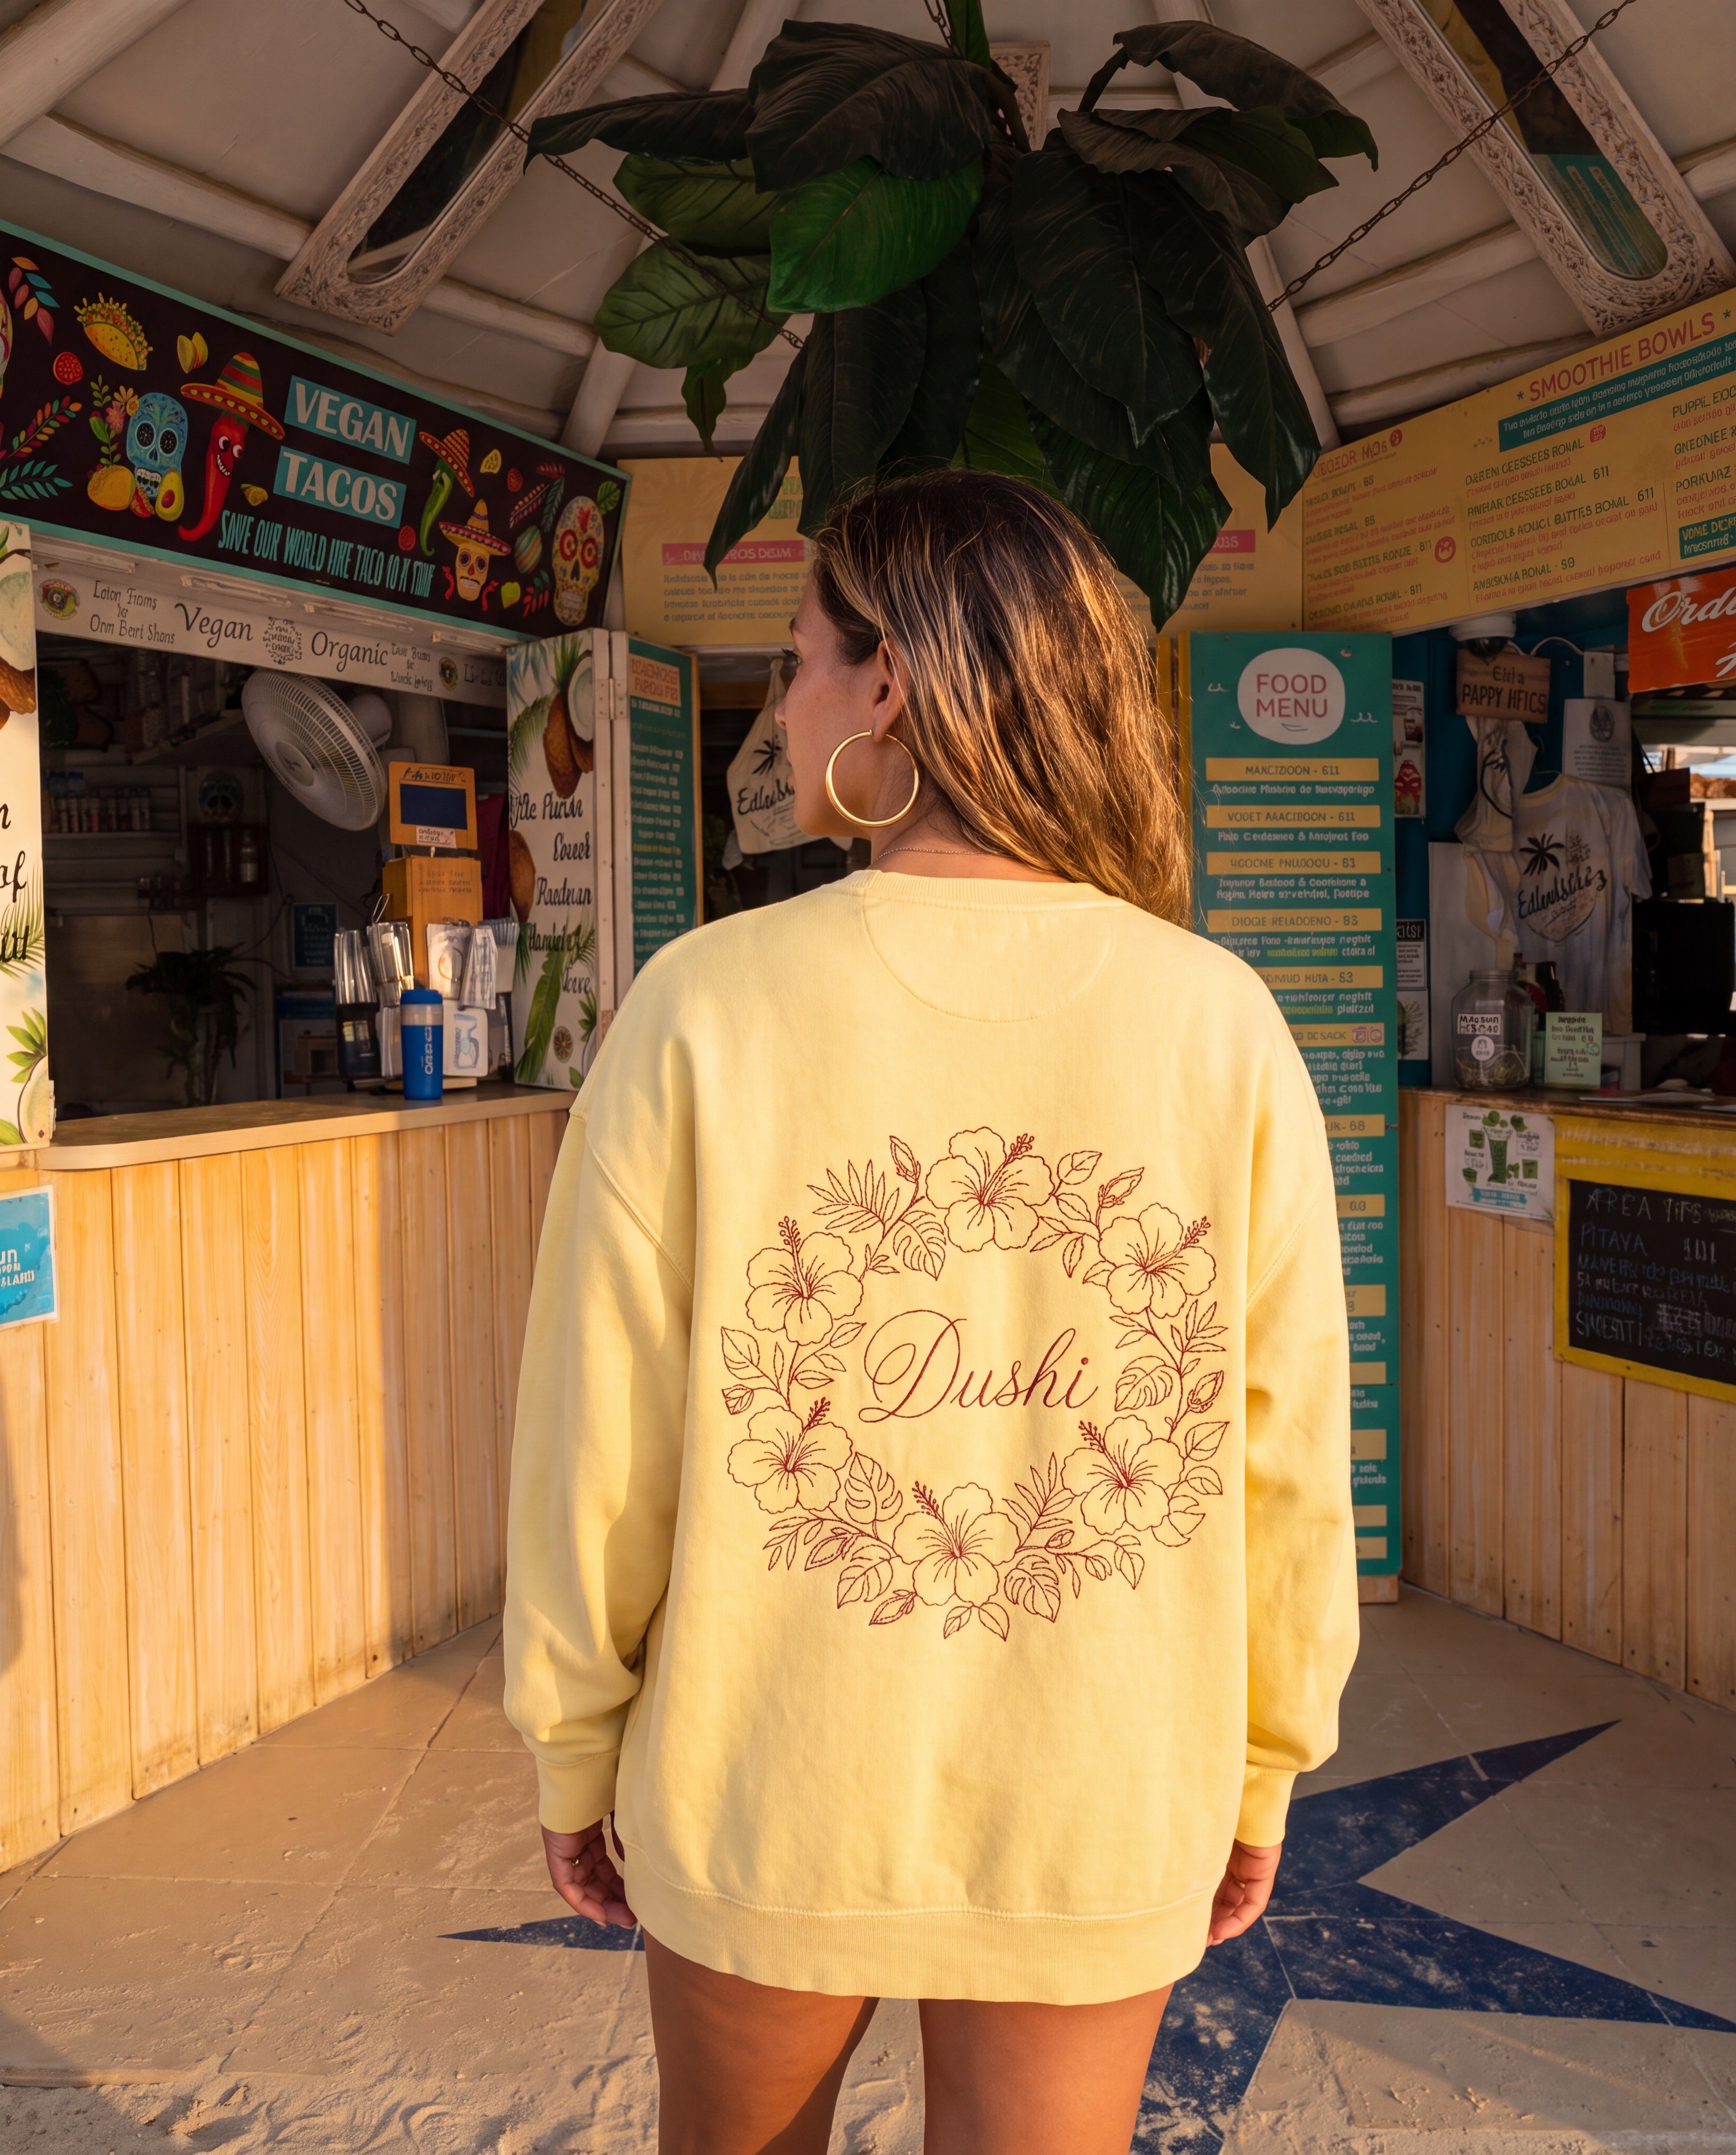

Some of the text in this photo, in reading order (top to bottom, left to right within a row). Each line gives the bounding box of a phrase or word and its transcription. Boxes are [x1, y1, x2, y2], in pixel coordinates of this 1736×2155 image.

[1530, 344, 1633, 401] SMOOTHIE
[1638, 312, 1715, 362] BOWLS
[296, 382, 409, 456] VEGAN
[283, 451, 397, 520] TACOS
[1593, 465, 1609, 480] 611
[1637, 487, 1654, 502] 611
[253, 520, 283, 561] OUR
[283, 527, 327, 571] WORLD
[174, 603, 253, 648] Vegan
[311, 631, 388, 672] Organic
[1257, 674, 1327, 694] FOOD
[1462, 684, 1504, 708] PAPPY
[1256, 698, 1328, 718] MENU
[1322, 766, 1340, 775] 611
[1338, 812, 1355, 822] 611
[858, 1310, 1098, 1423] Dushi
